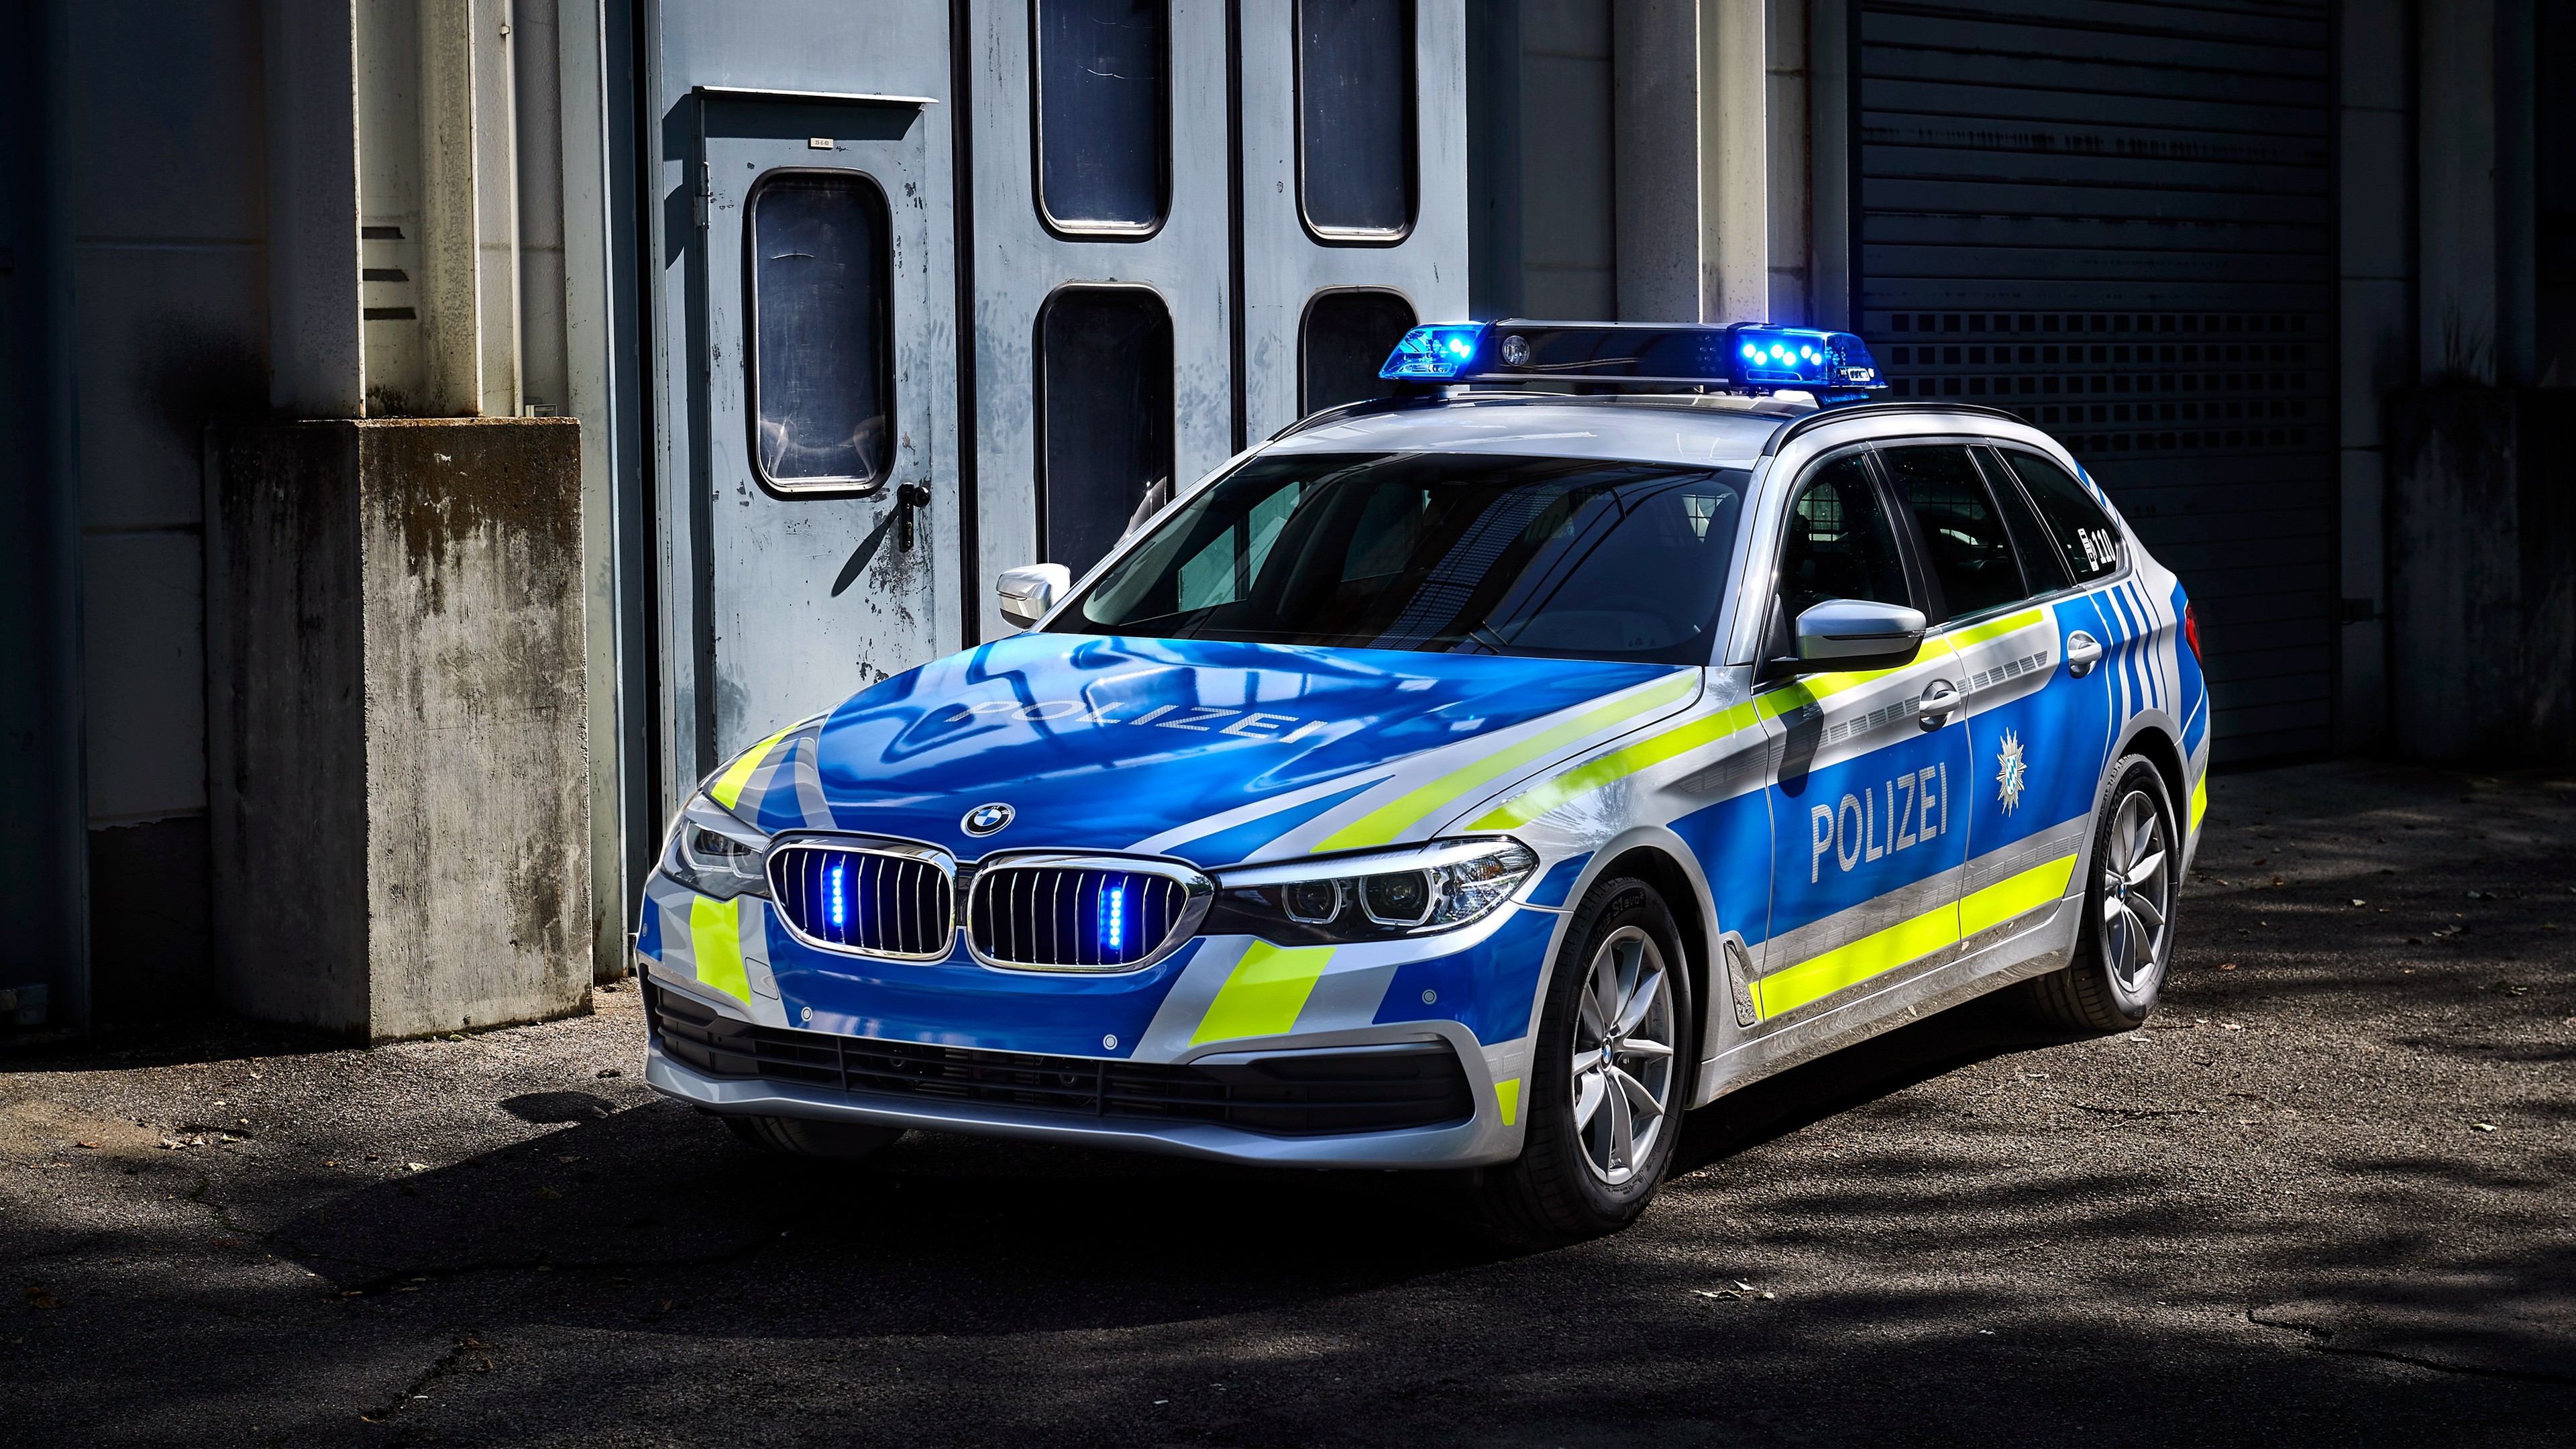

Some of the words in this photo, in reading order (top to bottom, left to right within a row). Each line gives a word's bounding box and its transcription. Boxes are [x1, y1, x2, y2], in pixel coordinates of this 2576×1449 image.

[2091, 529, 2116, 564] 110
[944, 700, 1328, 744] POLIZEI
[1811, 762, 1947, 884] POLIZEI
